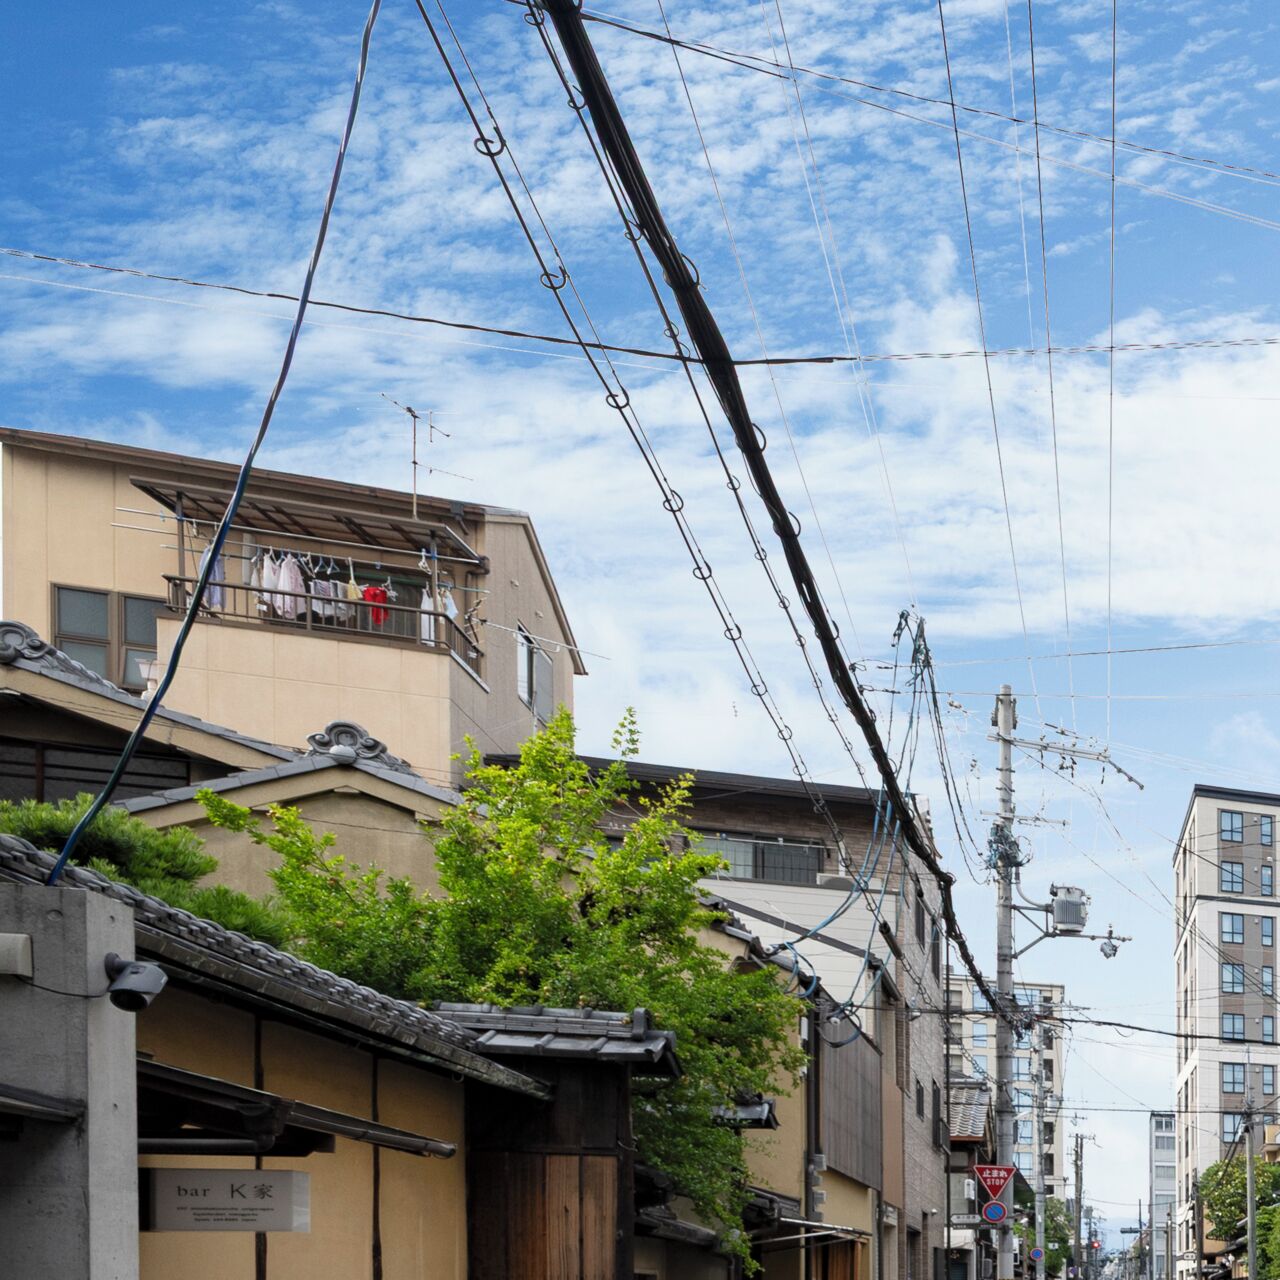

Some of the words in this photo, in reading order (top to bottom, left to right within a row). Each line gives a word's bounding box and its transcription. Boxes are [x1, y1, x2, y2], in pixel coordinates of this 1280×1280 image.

[982, 1169, 1008, 1178] 止まれ
[176, 1185, 211, 1197] bar
